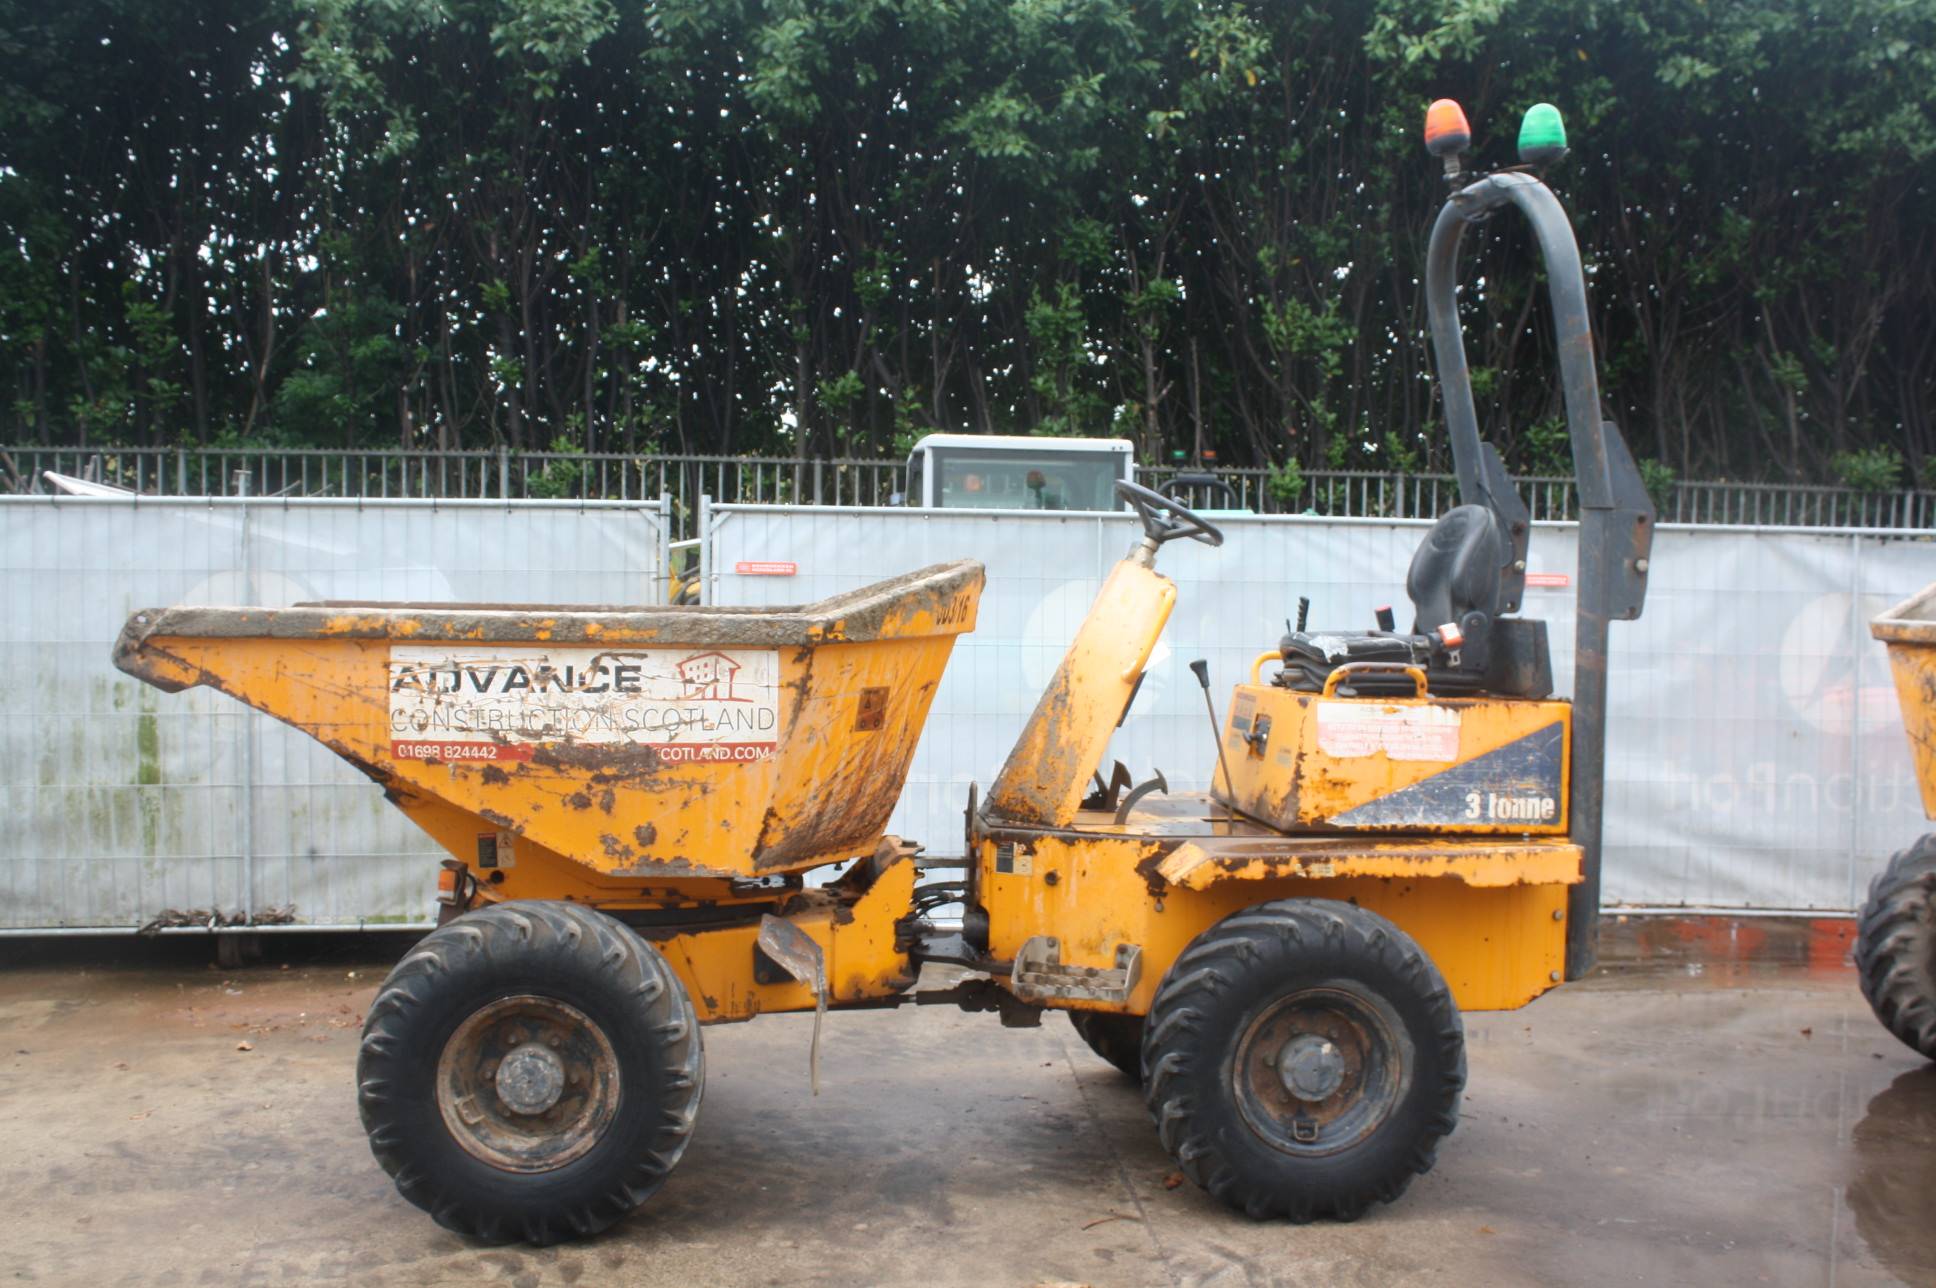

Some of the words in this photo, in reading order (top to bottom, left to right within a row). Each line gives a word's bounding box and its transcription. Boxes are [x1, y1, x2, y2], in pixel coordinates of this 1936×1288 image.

[391, 664, 642, 693] ADVANCE
[391, 707, 613, 733] CONSTRUCTION
[625, 707, 775, 732] SCOTLAND
[398, 744, 440, 759] 01698
[444, 745, 497, 759] 824442
[657, 745, 771, 760] COTLAND.COM
[1465, 792, 1481, 819] 3
[1488, 792, 1555, 819] tonne
